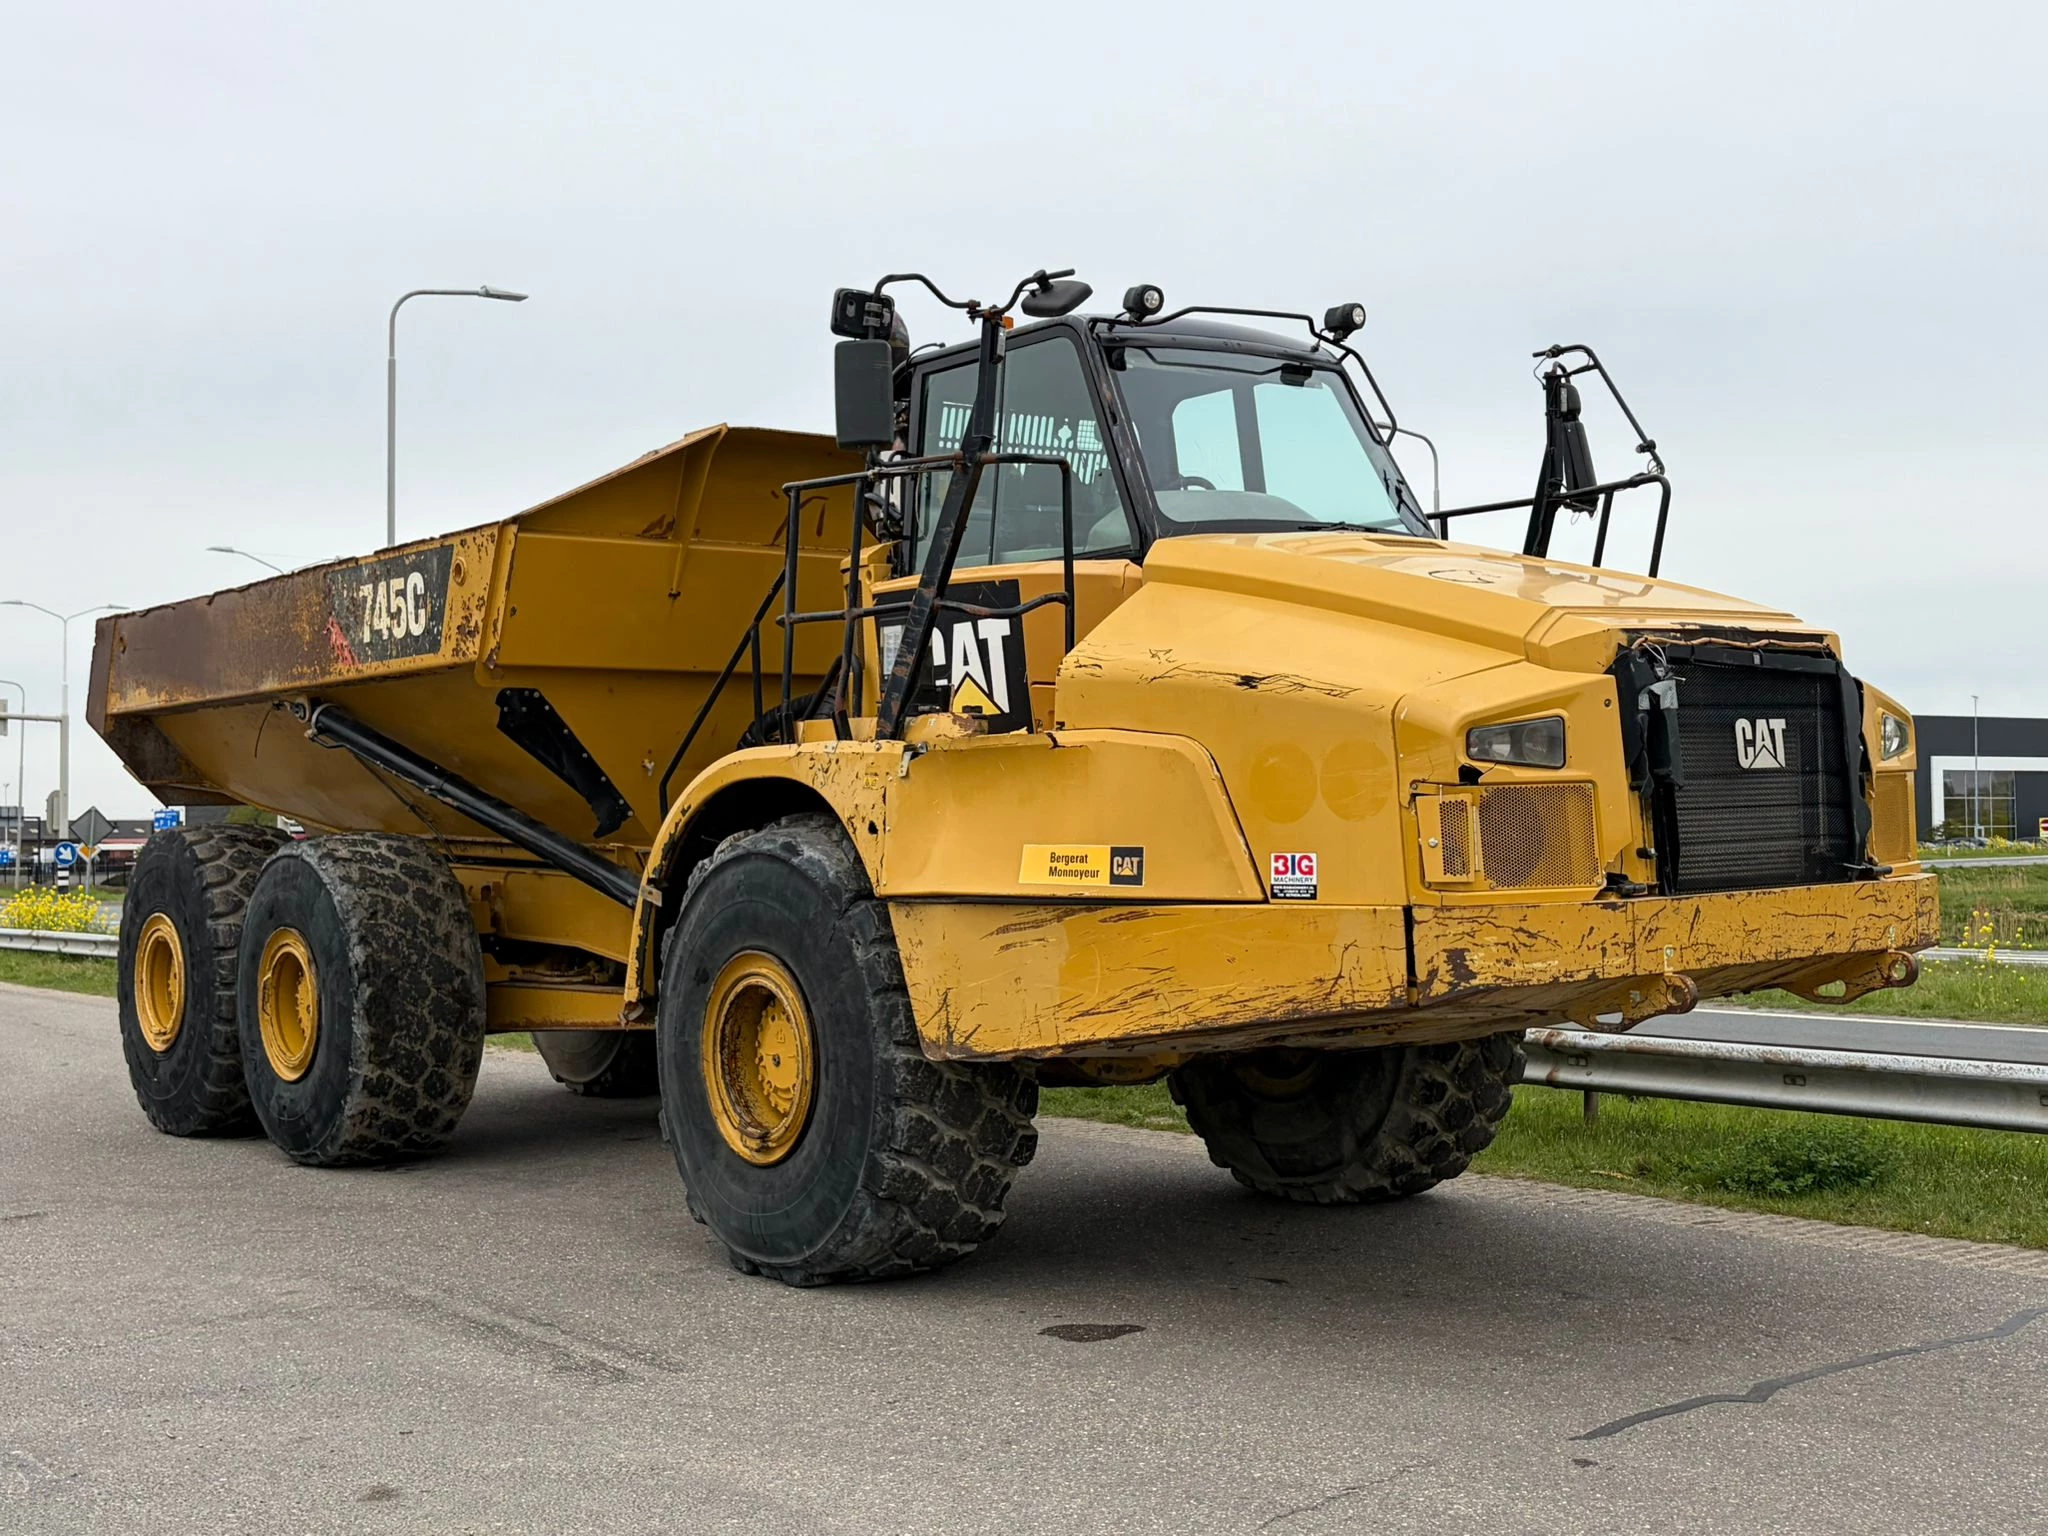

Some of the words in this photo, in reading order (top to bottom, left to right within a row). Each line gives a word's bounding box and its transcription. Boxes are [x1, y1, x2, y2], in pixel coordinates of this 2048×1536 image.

[359, 572, 426, 644] 745C
[1735, 718, 1786, 768] CAT
[1050, 852, 1088, 866] Bergerat
[1113, 856, 1140, 876] CAT
[1048, 866, 1100, 880] Monnoyeur
